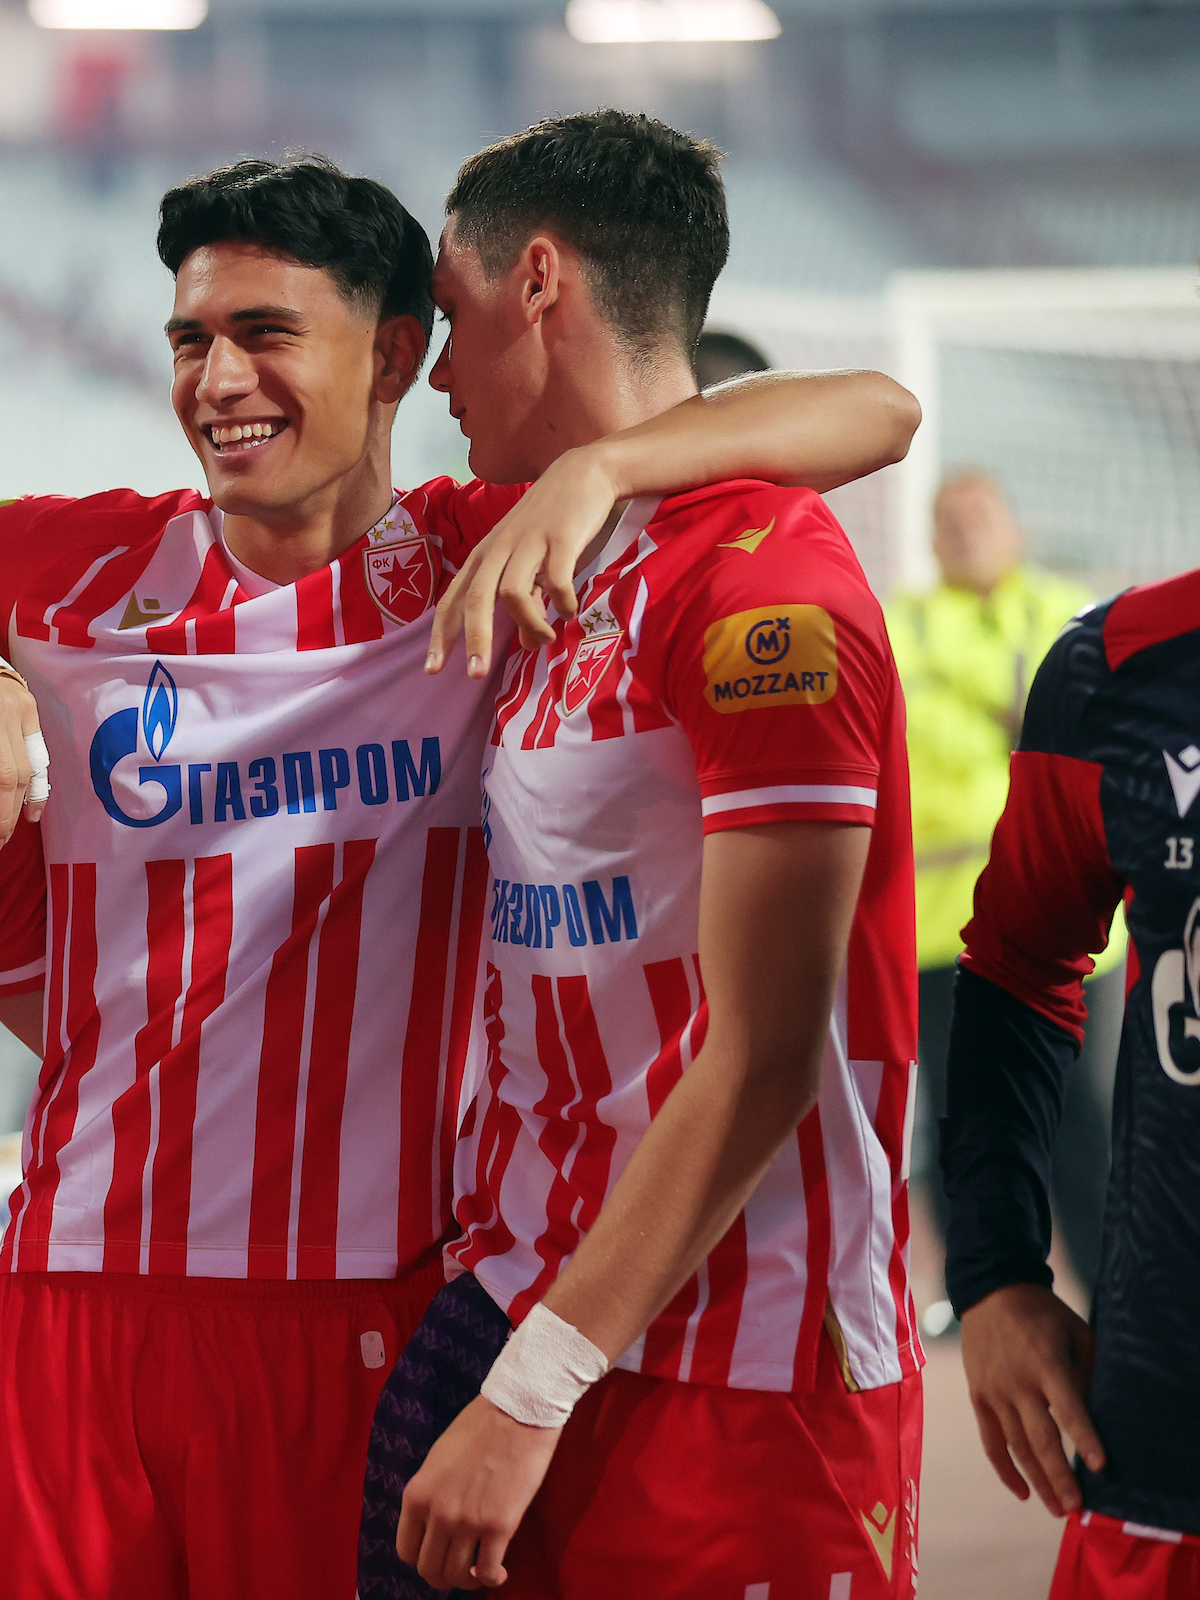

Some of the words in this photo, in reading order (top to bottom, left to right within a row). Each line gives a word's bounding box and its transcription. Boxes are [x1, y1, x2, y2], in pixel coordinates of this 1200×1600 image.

[372, 557, 390, 569] ФК
[714, 671, 829, 702] MOZZART
[188, 736, 442, 825] ГАЗПРОМ
[1163, 836, 1194, 869] 13
